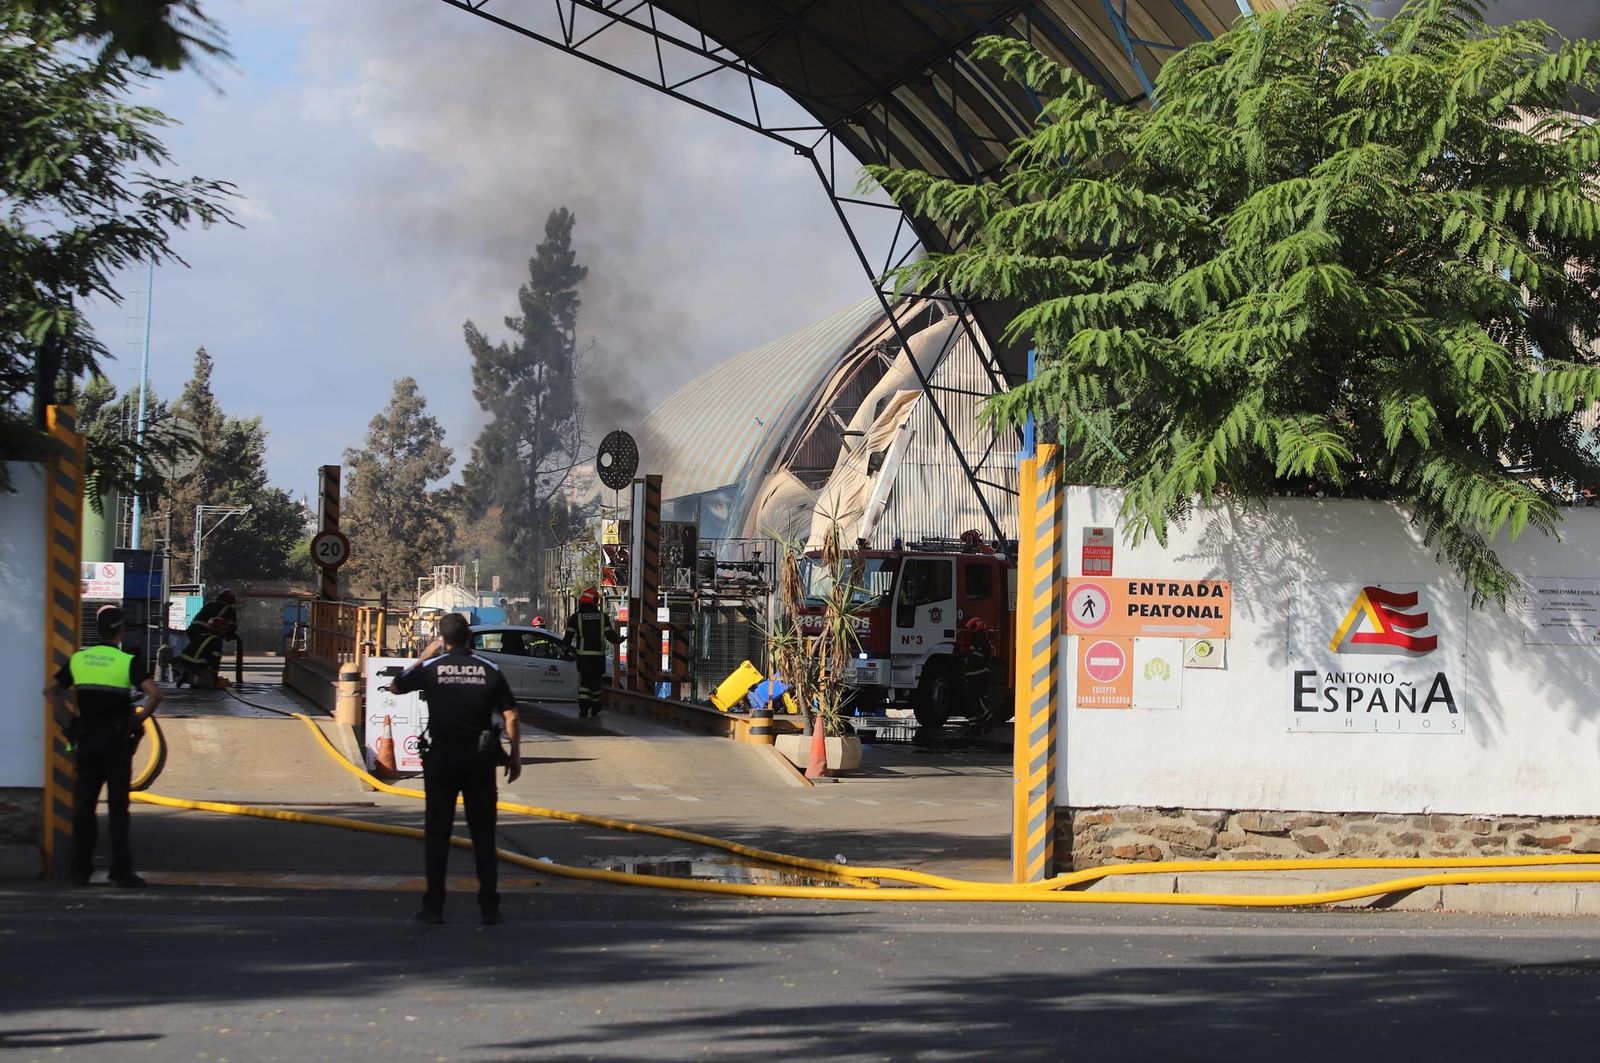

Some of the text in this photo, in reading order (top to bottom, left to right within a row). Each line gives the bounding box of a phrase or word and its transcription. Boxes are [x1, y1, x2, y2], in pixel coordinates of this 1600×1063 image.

[320, 542, 340, 556] 20
[1128, 582, 1224, 598] ENTRADA
[1127, 603, 1223, 619] PEATONAL
[437, 664, 486, 676] POLICIA
[437, 676, 486, 685] PORTUARIA
[1324, 672, 1395, 684] ANTONIO
[1092, 686, 1117, 694] EXCEPTO
[1293, 670, 1459, 714] ESPAÑA
[1078, 695, 1096, 704] CARGA
[1097, 696, 1101, 704] Y
[1101, 696, 1131, 704] DESCARGA
[1296, 718, 1457, 729] E HIJOS
[407, 740, 420, 750] 20
